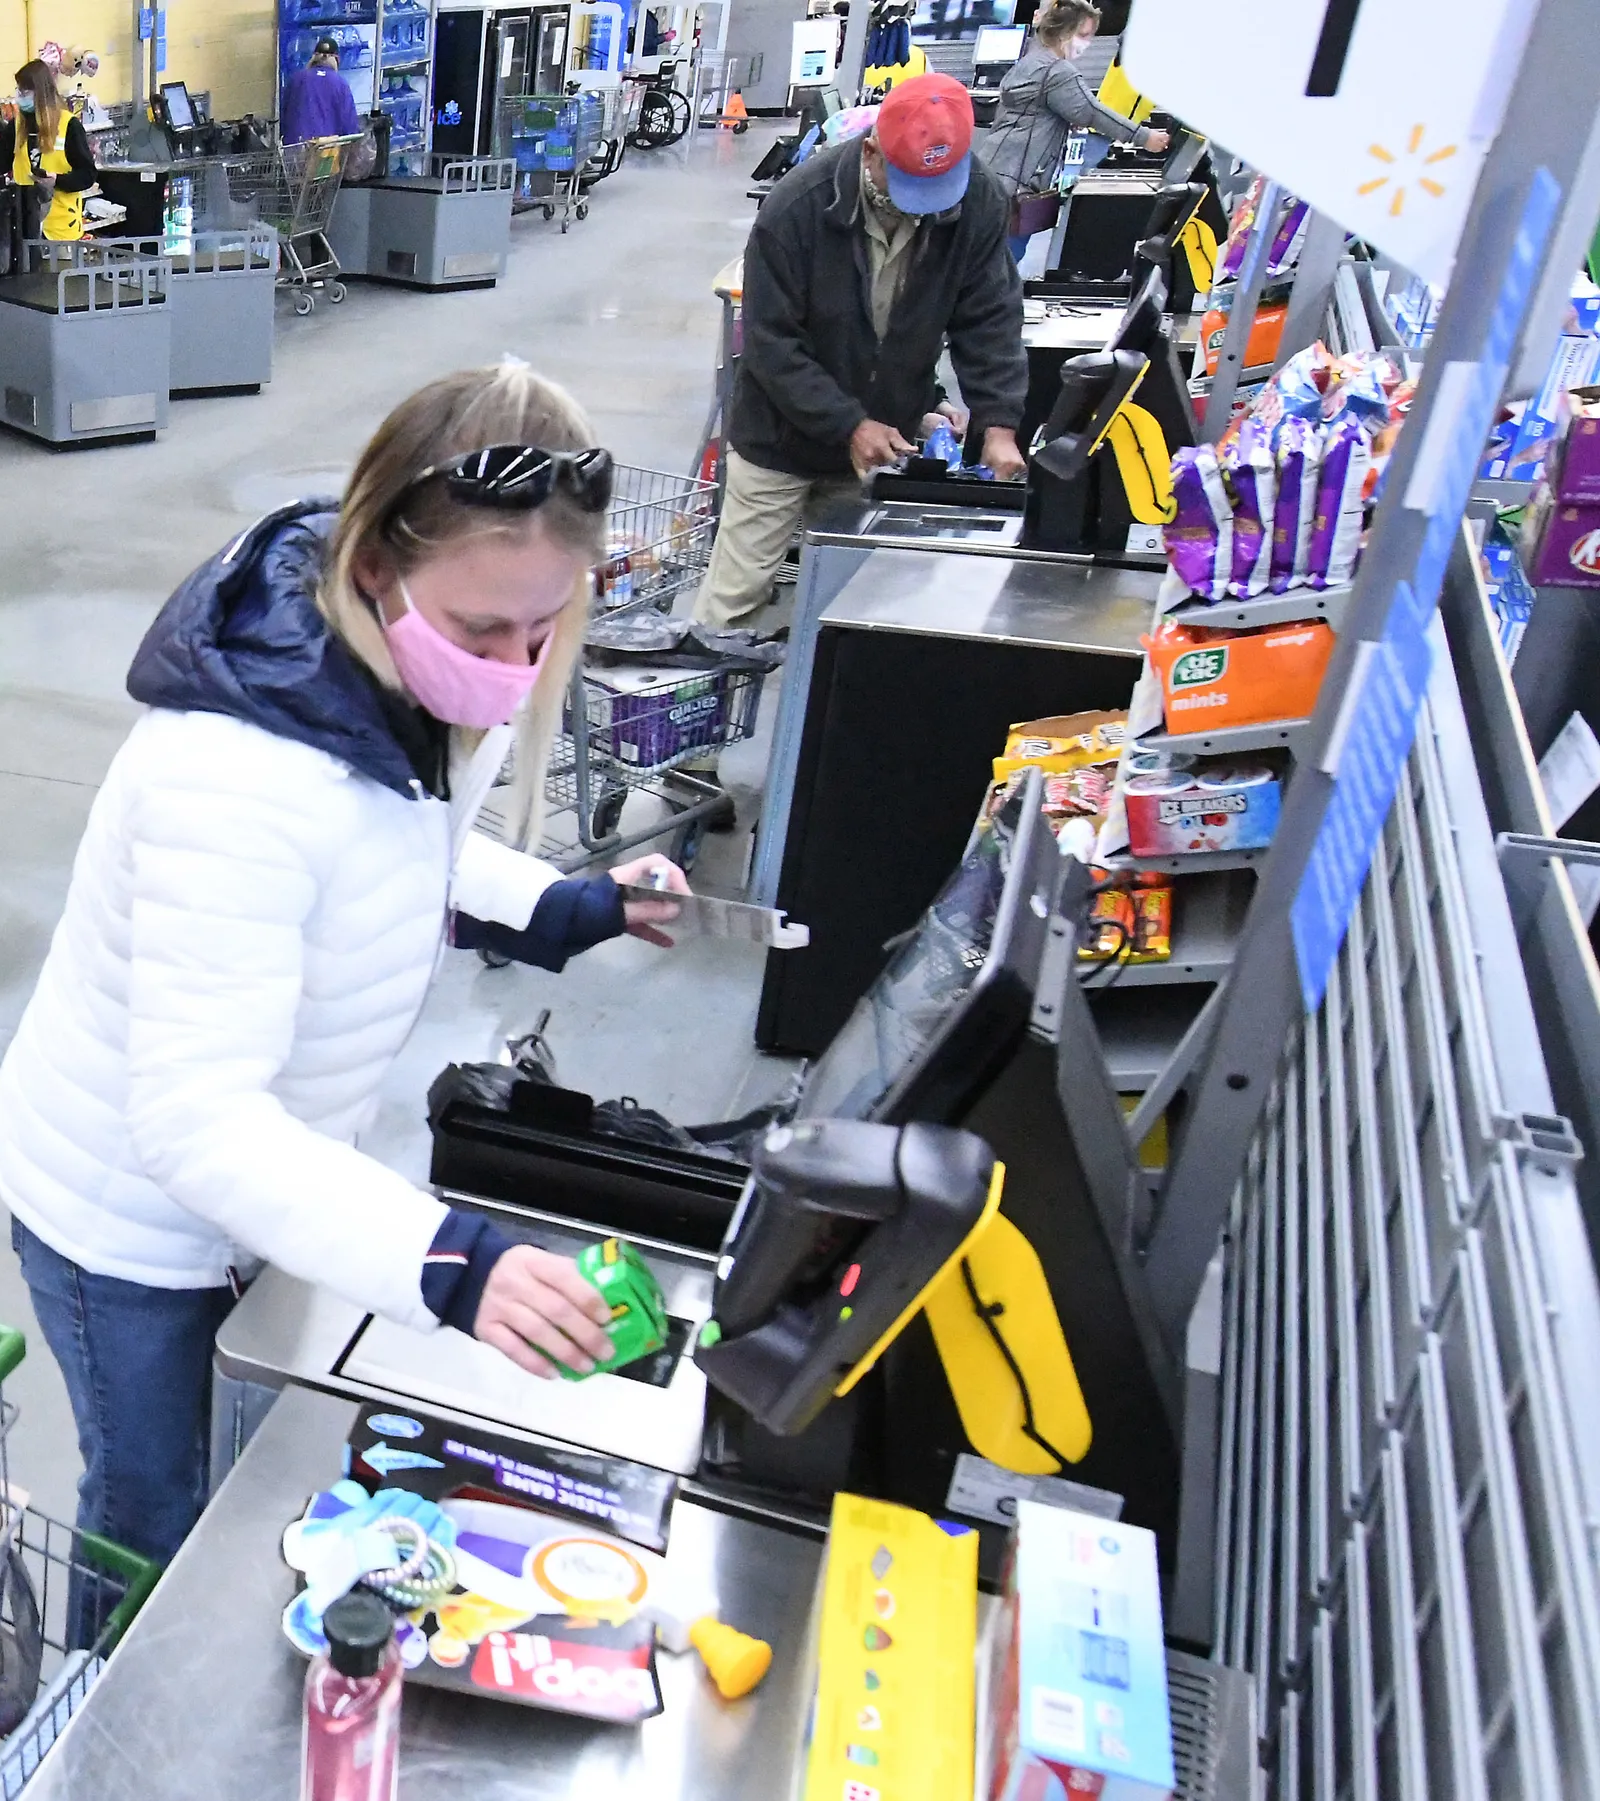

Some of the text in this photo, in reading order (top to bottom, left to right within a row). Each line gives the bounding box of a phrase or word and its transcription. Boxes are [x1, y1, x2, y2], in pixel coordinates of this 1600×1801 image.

[1188, 651, 1220, 669] tic
[1180, 666, 1219, 682] tac
[1171, 692, 1229, 711] mints
[531, 1658, 658, 1711] bop
